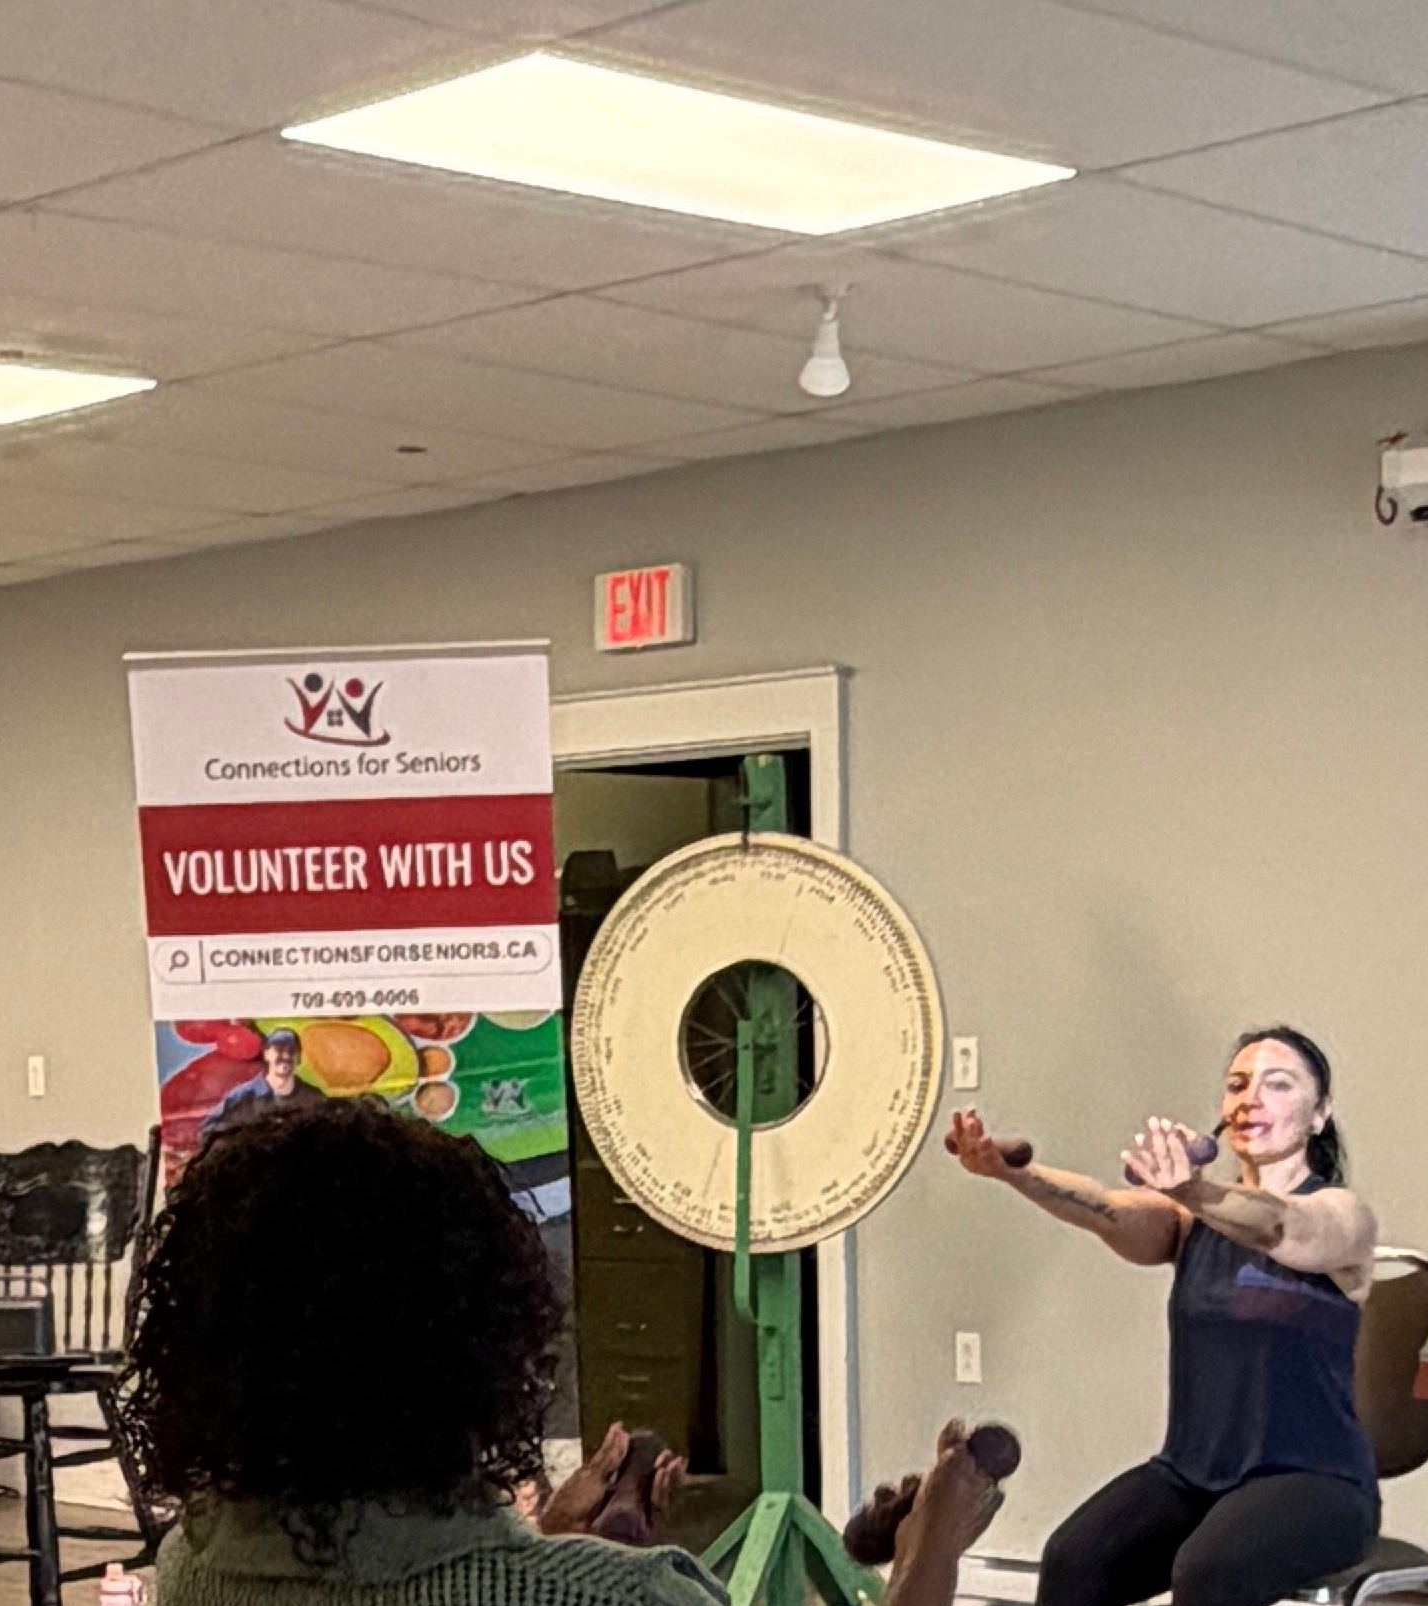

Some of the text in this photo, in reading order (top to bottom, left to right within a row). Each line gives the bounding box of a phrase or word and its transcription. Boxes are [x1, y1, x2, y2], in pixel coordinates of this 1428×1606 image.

[608, 567, 671, 643] EXIT
[204, 750, 482, 782] Connections for Seniors
[163, 840, 535, 896] VOLUNTEER WITH US
[208, 940, 538, 968] CONNECTIONSFORSENIORS.CA
